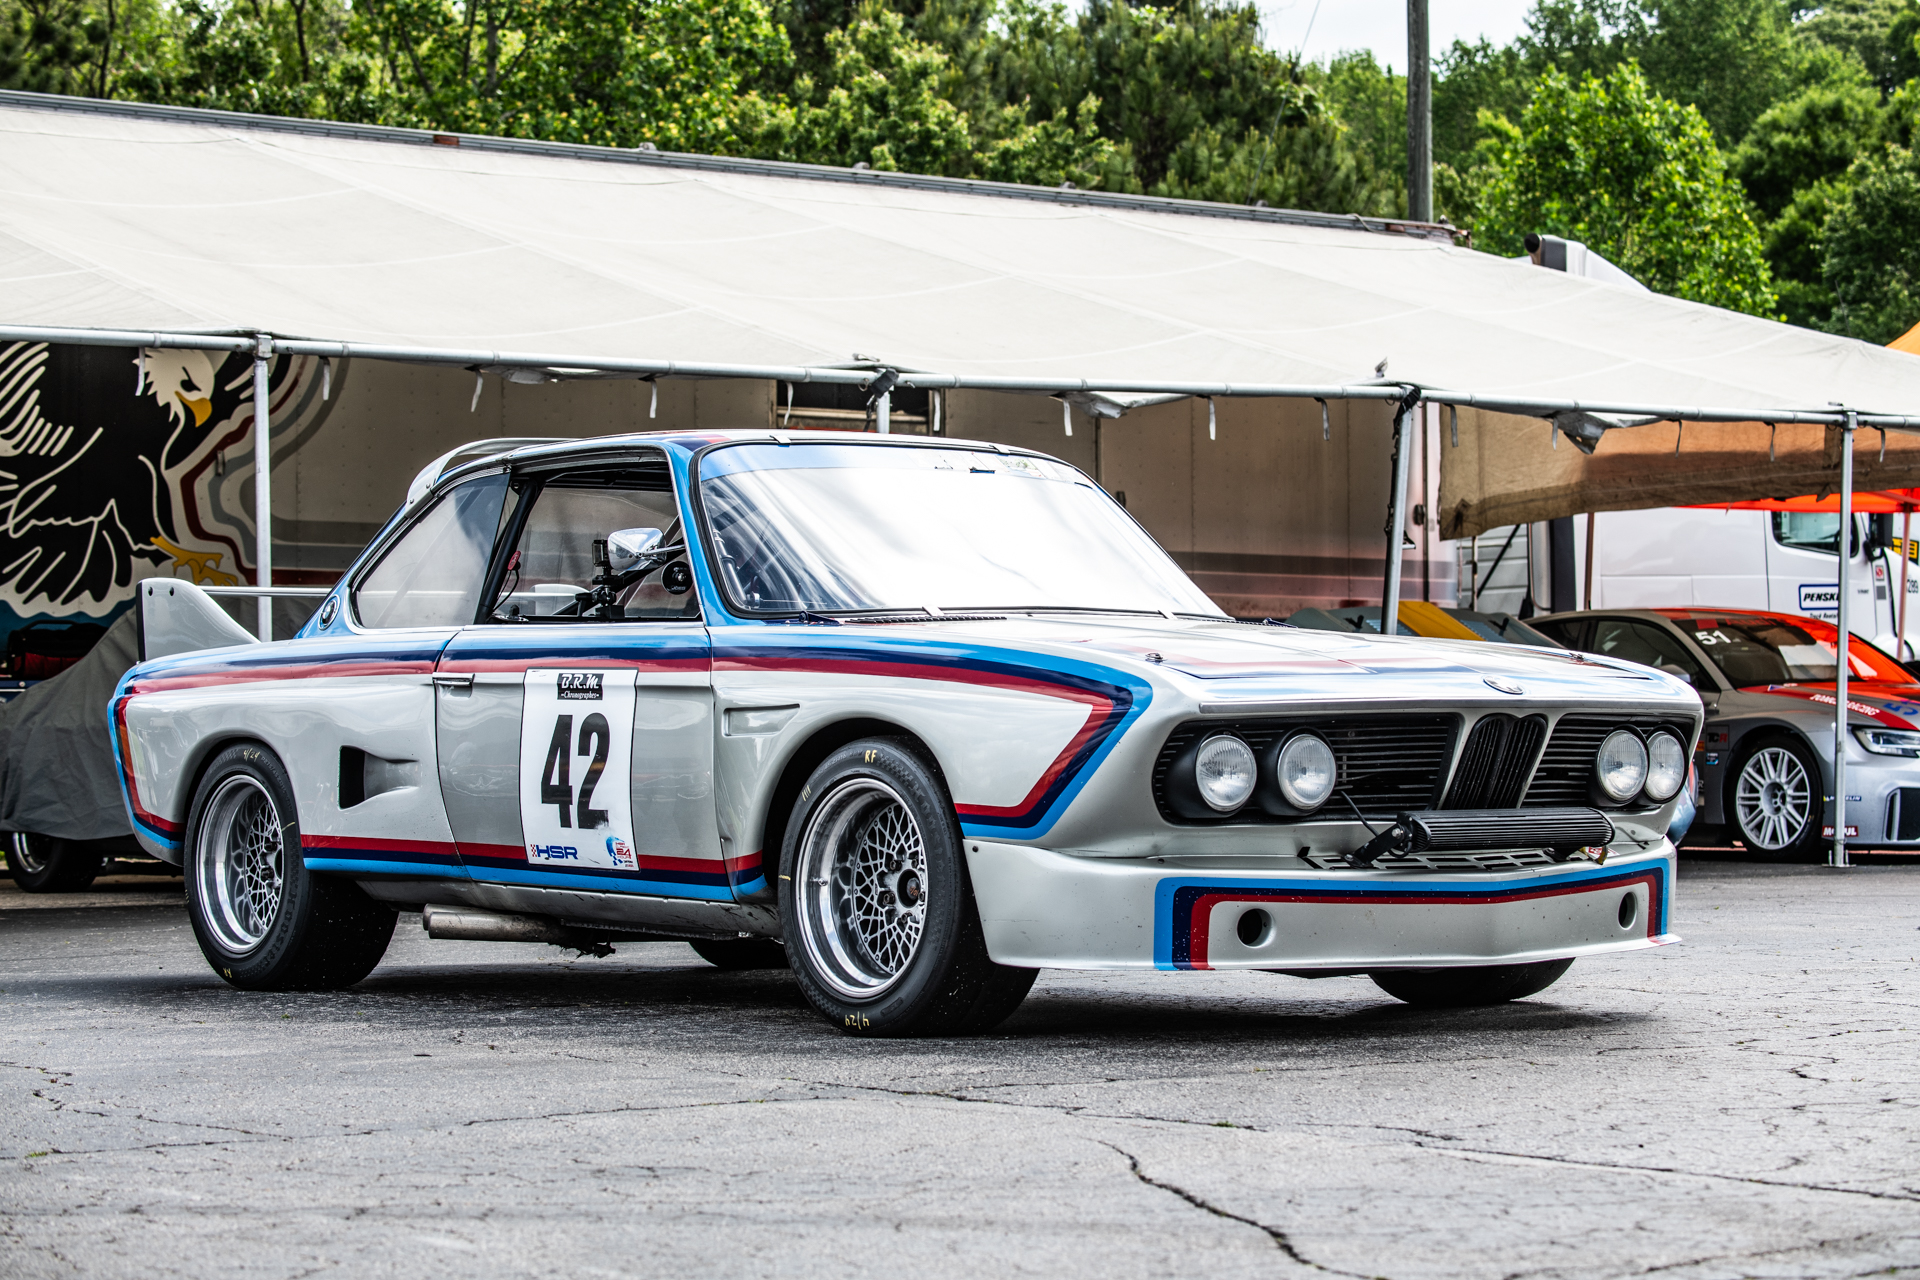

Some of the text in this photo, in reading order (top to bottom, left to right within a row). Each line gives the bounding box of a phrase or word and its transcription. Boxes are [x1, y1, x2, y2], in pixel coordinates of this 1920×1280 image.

[1695, 630, 1731, 645] 51
[1707, 732, 1728, 743] TCR
[864, 749, 878, 764] RF
[541, 712, 610, 830] 42
[1823, 827, 1857, 836] MUL
[536, 844, 579, 860] HSR
